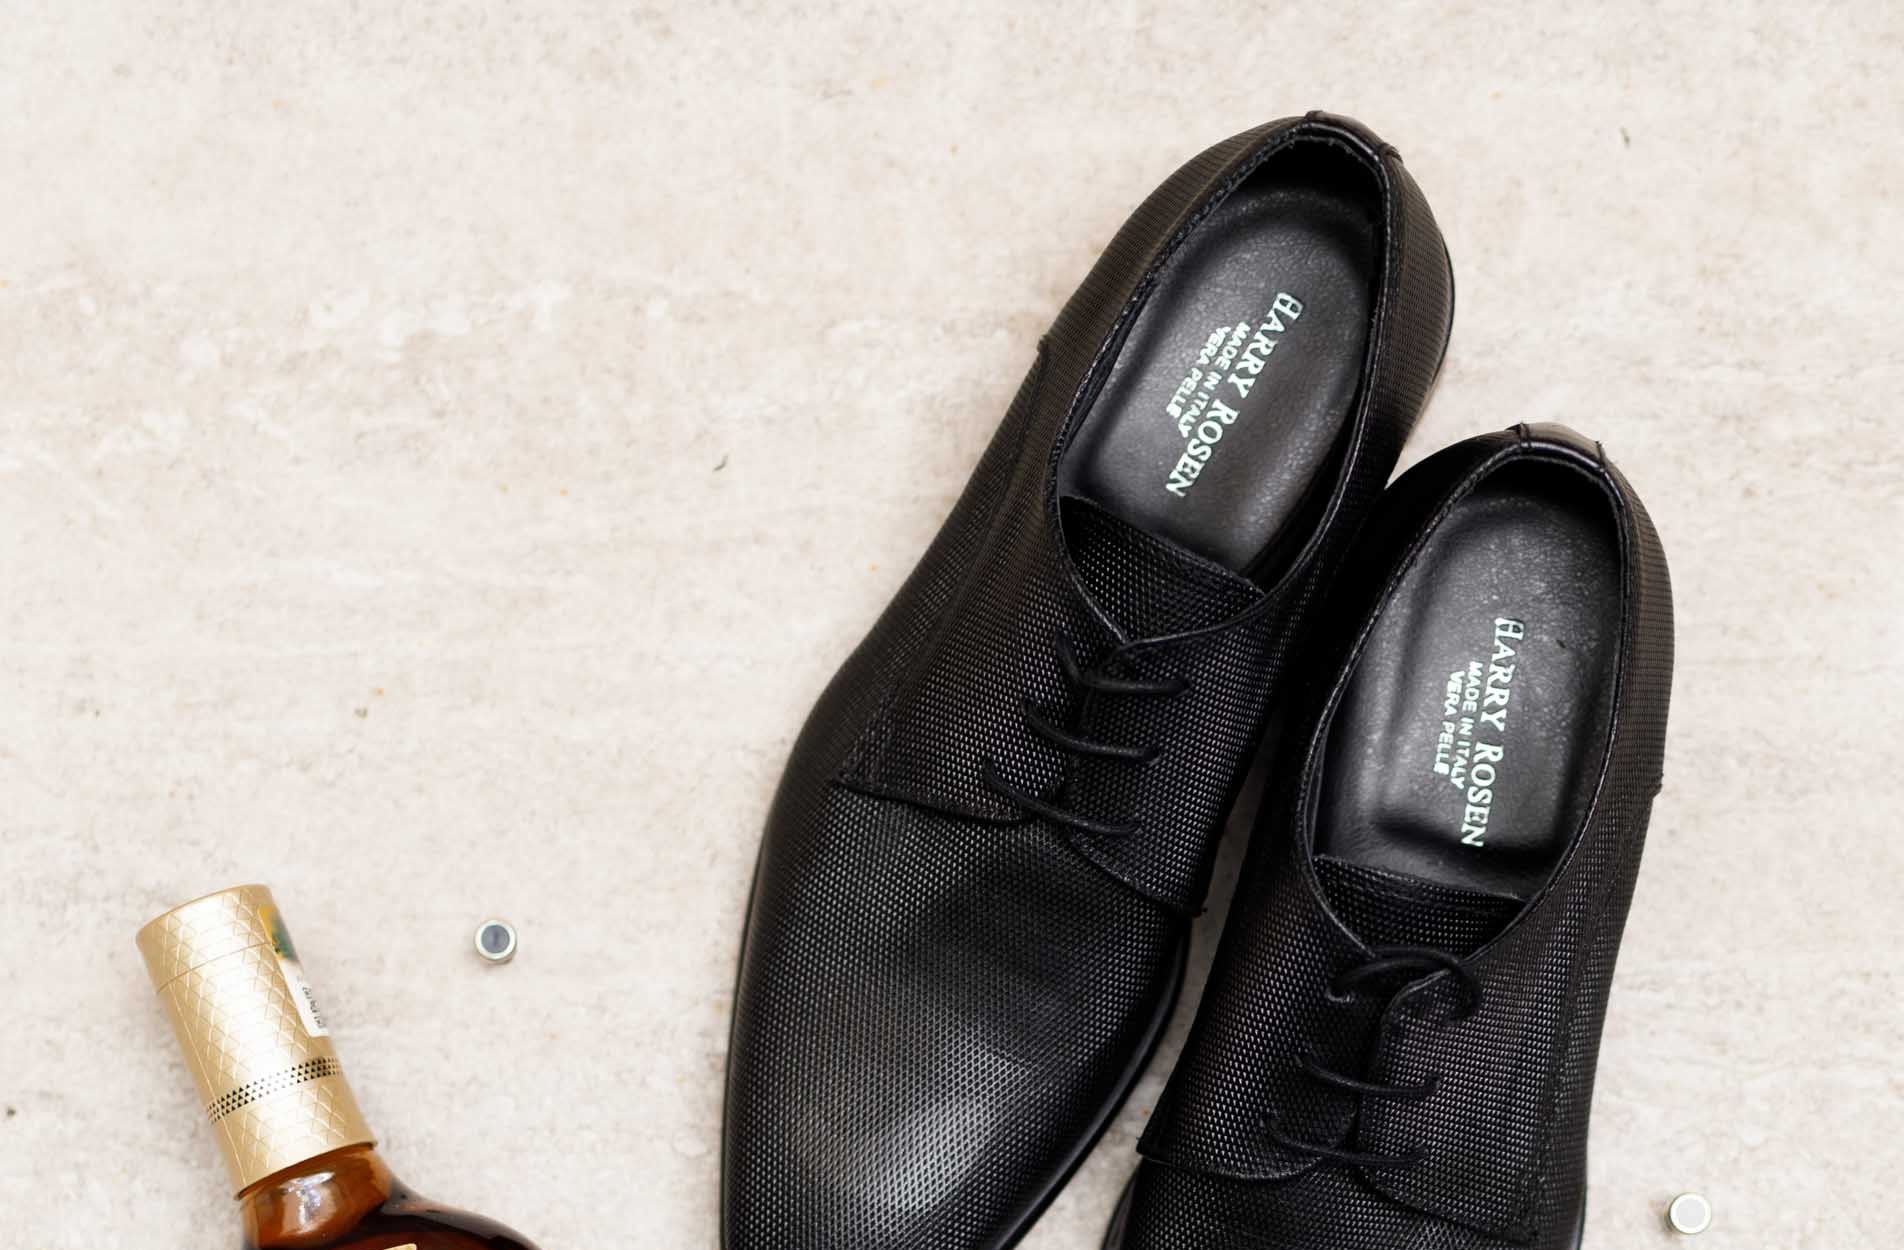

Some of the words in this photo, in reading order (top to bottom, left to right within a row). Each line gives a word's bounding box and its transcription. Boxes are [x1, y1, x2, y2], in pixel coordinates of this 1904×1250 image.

[1196, 326, 1231, 365] VERA
[1215, 321, 1250, 370] MADE
[1227, 292, 1304, 398] HARRY
[1166, 367, 1203, 419] PELLE
[1203, 371, 1222, 390] IN
[1178, 392, 1209, 438] ITALY
[1166, 400, 1240, 497] ROSEN
[1444, 670, 1465, 716] VERA
[1462, 661, 1483, 713] MADE
[1481, 617, 1525, 732] HARRY
[1433, 721, 1455, 776] PELLE
[1459, 718, 1475, 736] IN
[1451, 740, 1471, 790] ITALY
[1461, 742, 1504, 848] ROSEN
